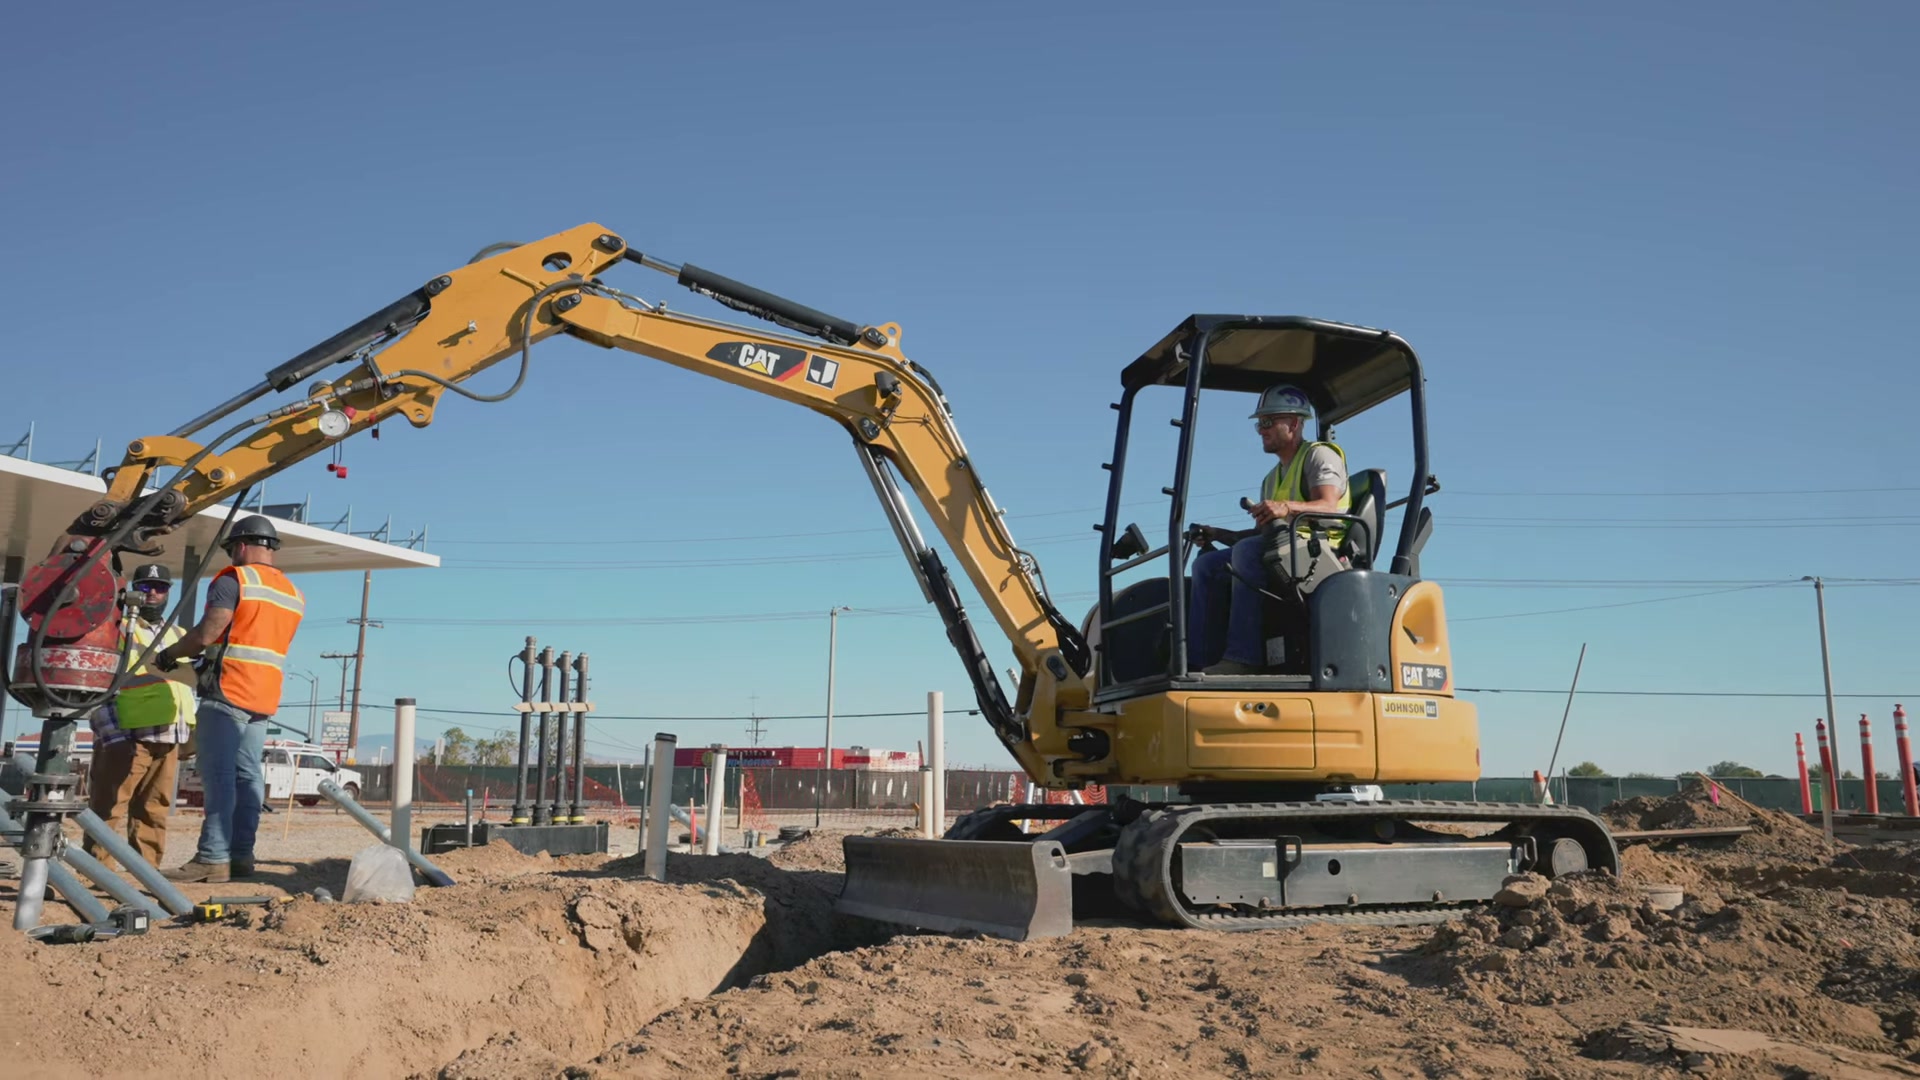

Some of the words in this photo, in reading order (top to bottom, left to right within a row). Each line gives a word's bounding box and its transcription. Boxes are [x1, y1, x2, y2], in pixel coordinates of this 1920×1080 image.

[738, 344, 781, 375] CAT
[148, 565, 159, 577] A
[1403, 665, 1423, 686] CAT
[1385, 702, 1424, 713] JOHNSON
